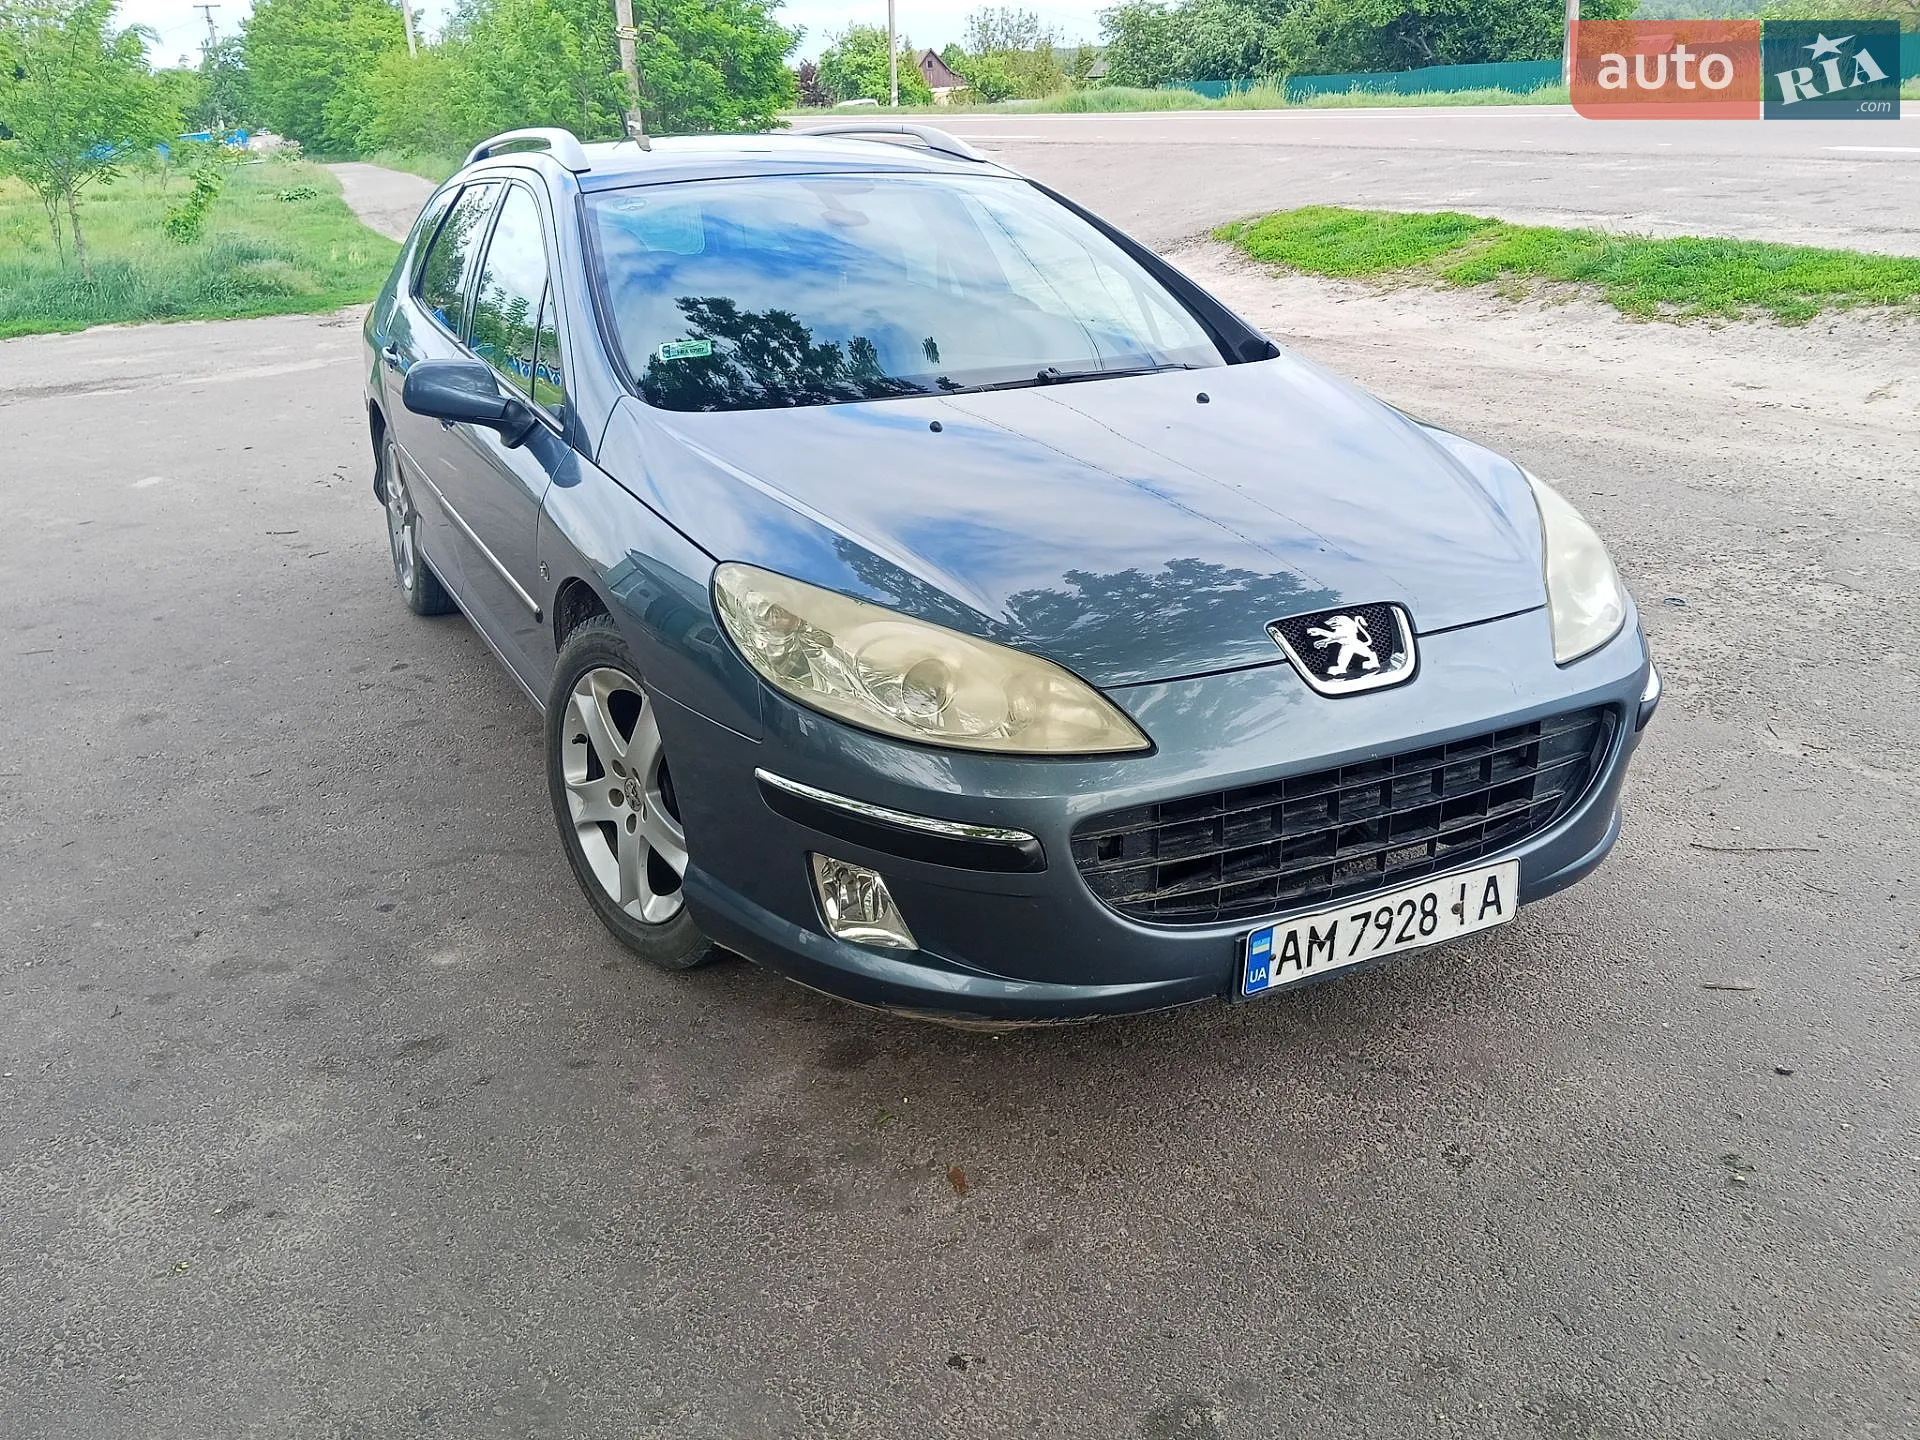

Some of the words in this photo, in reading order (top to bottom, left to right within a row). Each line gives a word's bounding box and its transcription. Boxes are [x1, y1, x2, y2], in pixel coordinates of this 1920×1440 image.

[1275, 919, 1338, 976] AM
[1348, 892, 1438, 957] 7928
[1459, 875, 1502, 925] IA
[1249, 966, 1267, 984] UA
